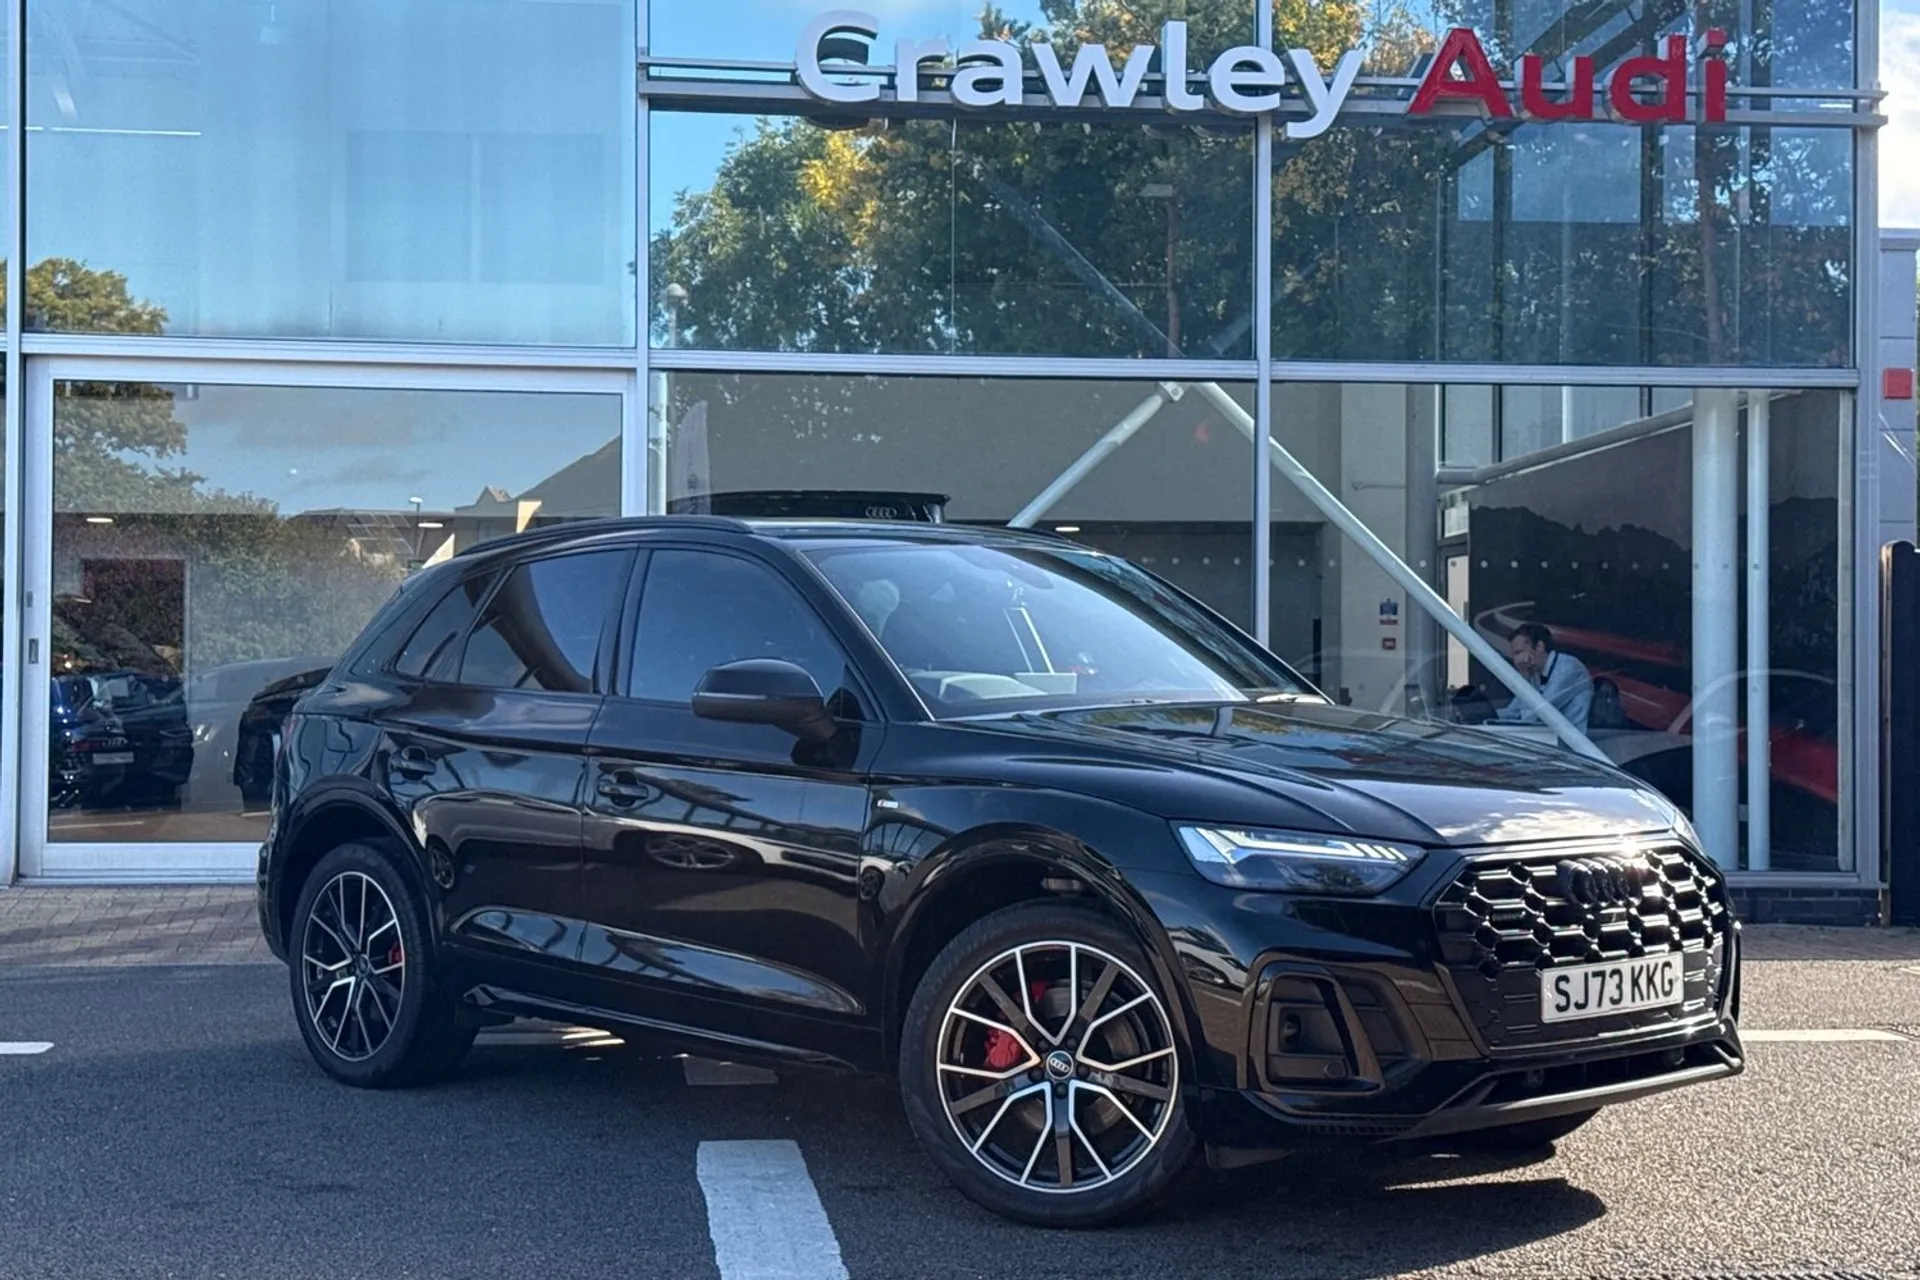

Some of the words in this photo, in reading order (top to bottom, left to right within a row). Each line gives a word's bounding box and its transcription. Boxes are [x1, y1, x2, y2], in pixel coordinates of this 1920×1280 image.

[796, 10, 1365, 138] Crawley
[1405, 27, 1726, 122] Audi
[1554, 968, 1623, 1013] SJ73
[1630, 961, 1674, 1003] KKG
